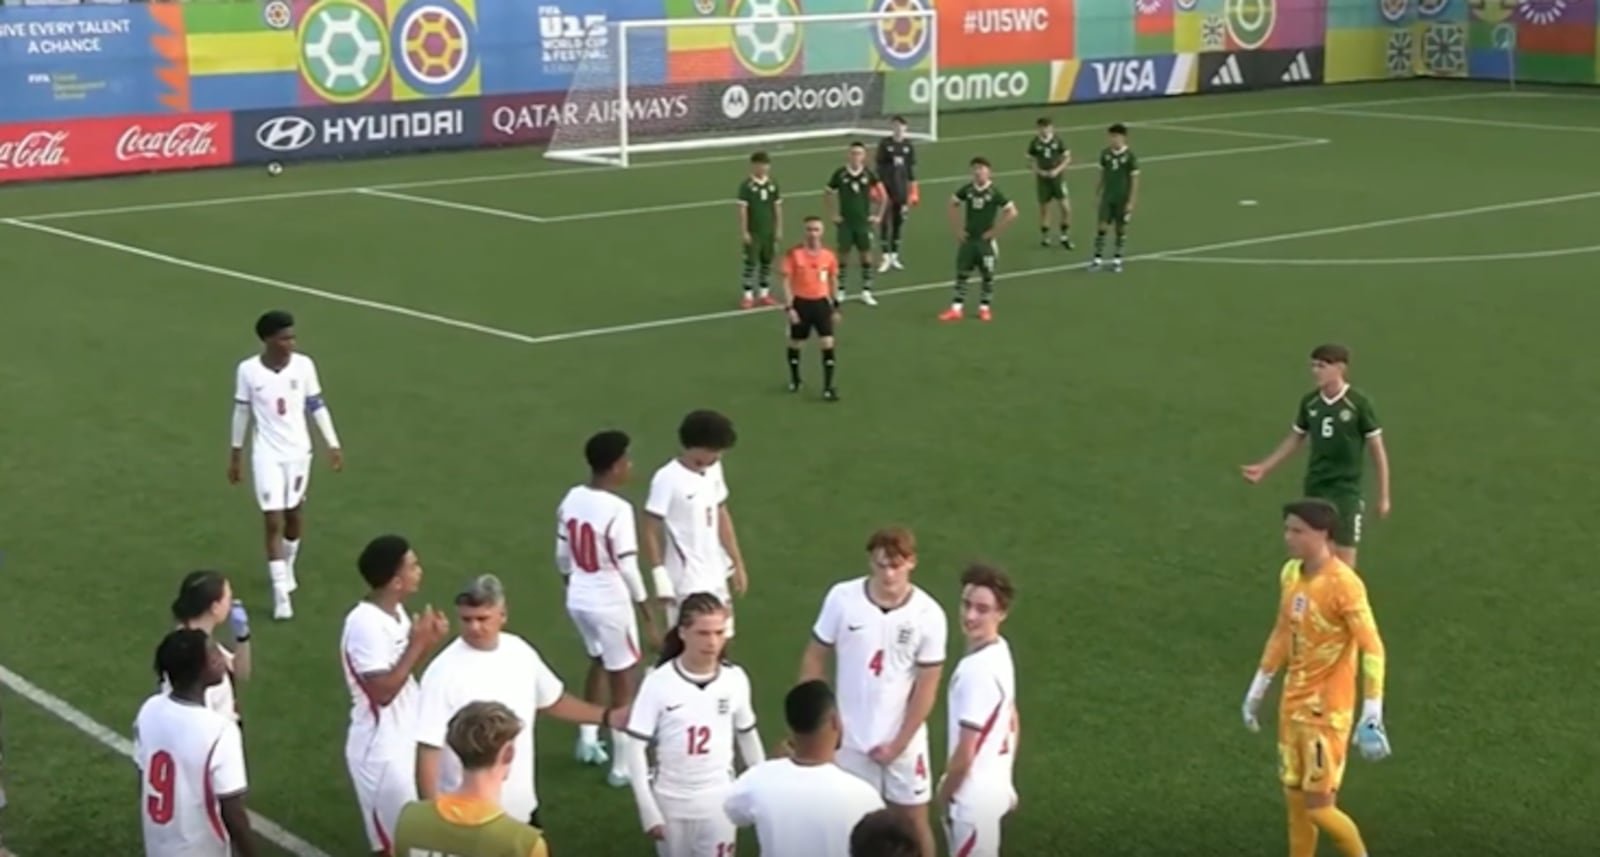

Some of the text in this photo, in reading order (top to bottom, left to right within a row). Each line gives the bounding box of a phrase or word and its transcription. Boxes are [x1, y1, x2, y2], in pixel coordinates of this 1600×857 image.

[29, 21, 75, 36] EVERY
[77, 19, 131, 34] TALENT
[539, 14, 608, 38] U15
[963, 8, 1049, 35] #U15WC
[28, 37, 102, 54] A CHANCE
[542, 36, 608, 50] WORLD CUP
[910, 70, 1029, 103] aramco
[1090, 59, 1156, 95] VISA
[752, 83, 864, 112] motorola
[323, 109, 462, 143] HYUNDAI
[492, 95, 689, 135] QATAR AIRWAYS
[116, 121, 218, 161] Coca-Cola
[1321, 416, 1335, 438] 6
[566, 517, 600, 573] 10
[869, 649, 885, 677] 4
[687, 725, 711, 755] 12
[1315, 740, 1323, 769] 1
[915, 753, 926, 779] 4
[147, 749, 176, 826] 9
